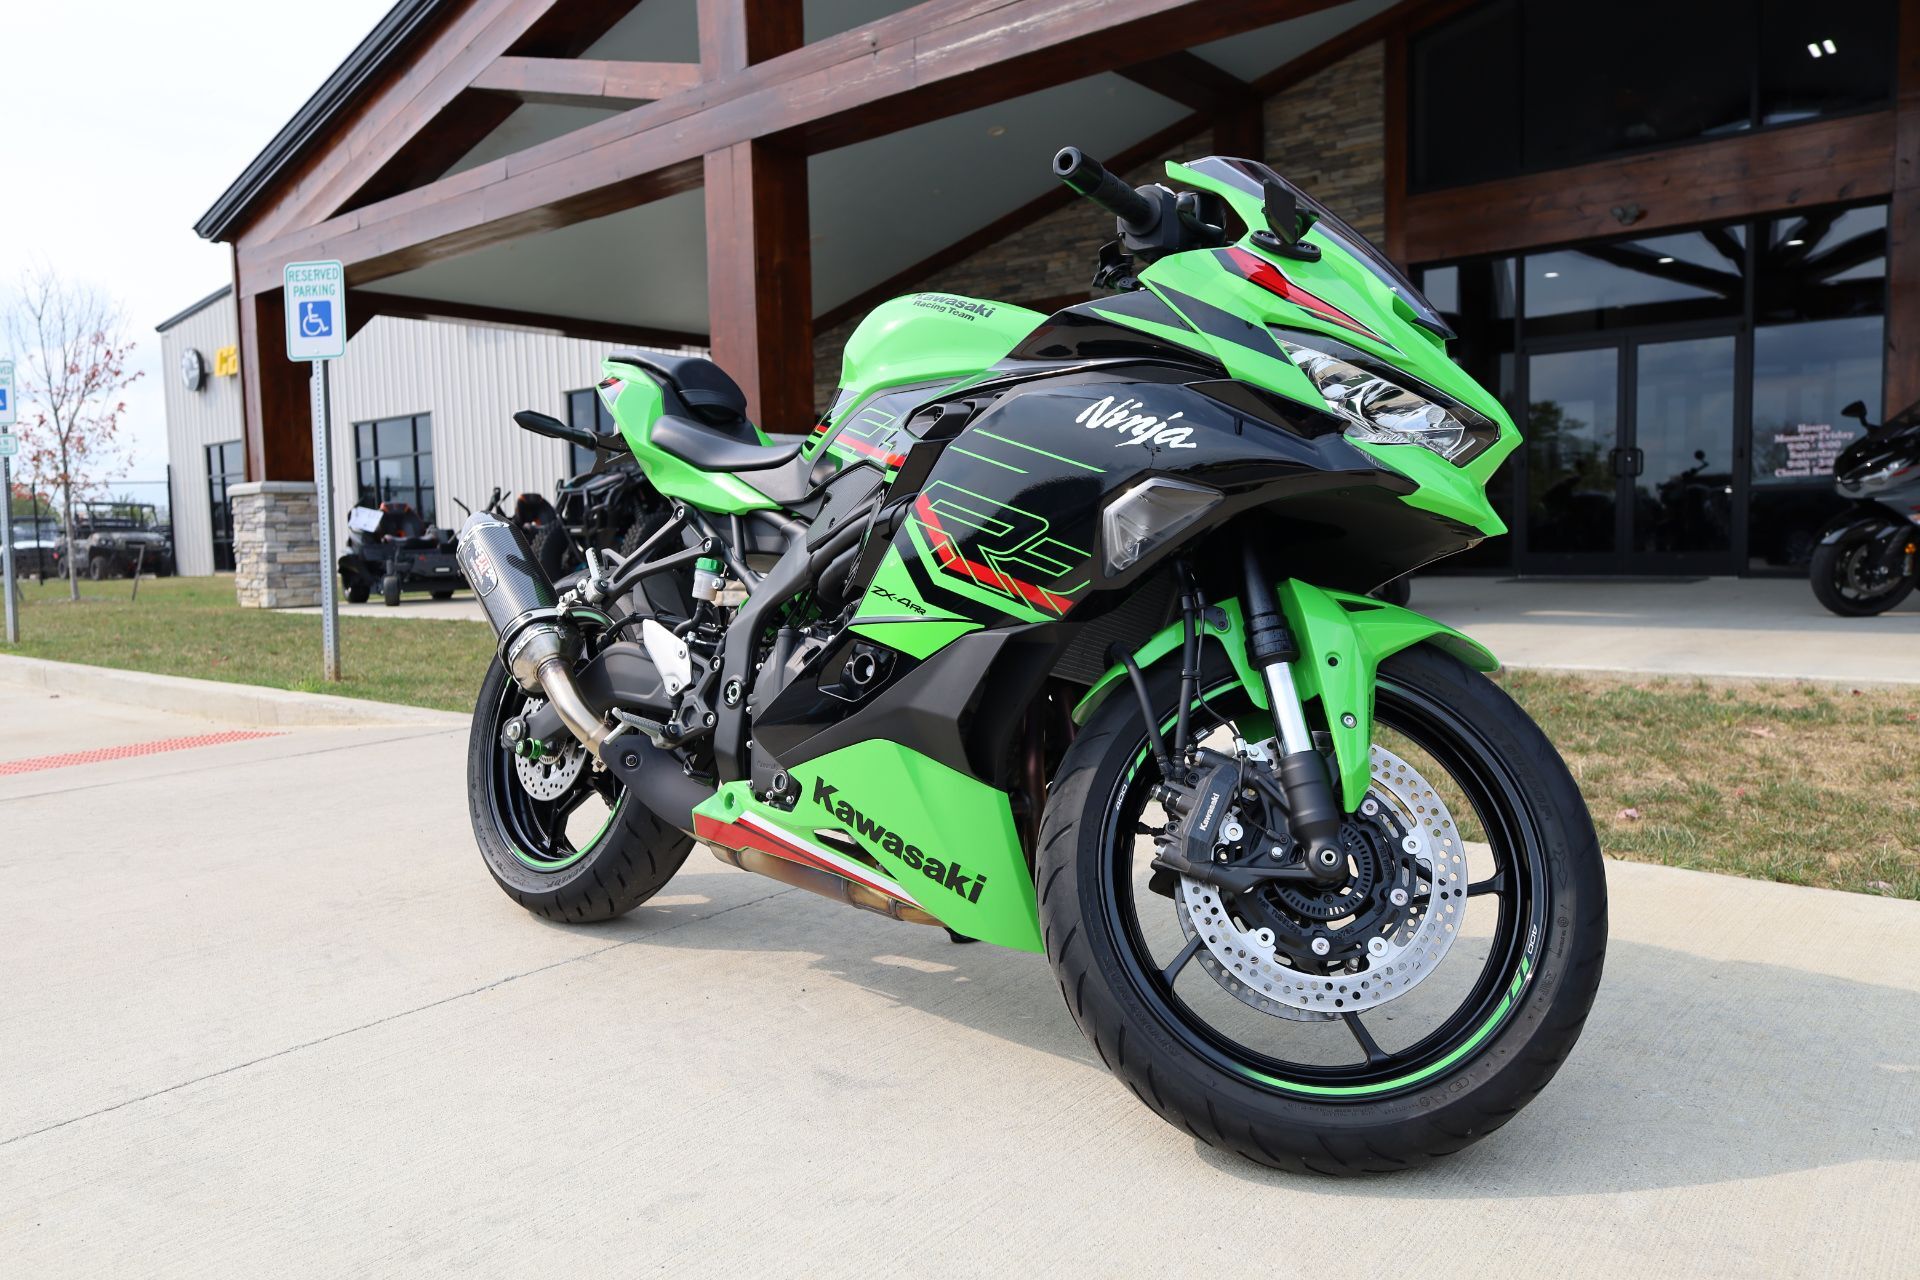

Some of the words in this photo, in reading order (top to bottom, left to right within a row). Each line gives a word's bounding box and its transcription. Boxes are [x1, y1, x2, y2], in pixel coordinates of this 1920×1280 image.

[288, 267, 339, 282] RESERVED
[293, 283, 336, 297] PARKING
[912, 293, 996, 318] Kawasaki
[913, 300, 947, 313] Racing
[947, 306, 976, 321] Team
[1075, 396, 1197, 449] Ninja
[1797, 424, 1831, 433] Hours
[1774, 467, 1811, 478] Closed
[1115, 783, 1128, 811] 400
[1199, 792, 1220, 831] Kawasaki
[813, 776, 988, 904] Kawasaki
[1527, 923, 1538, 955] 400
